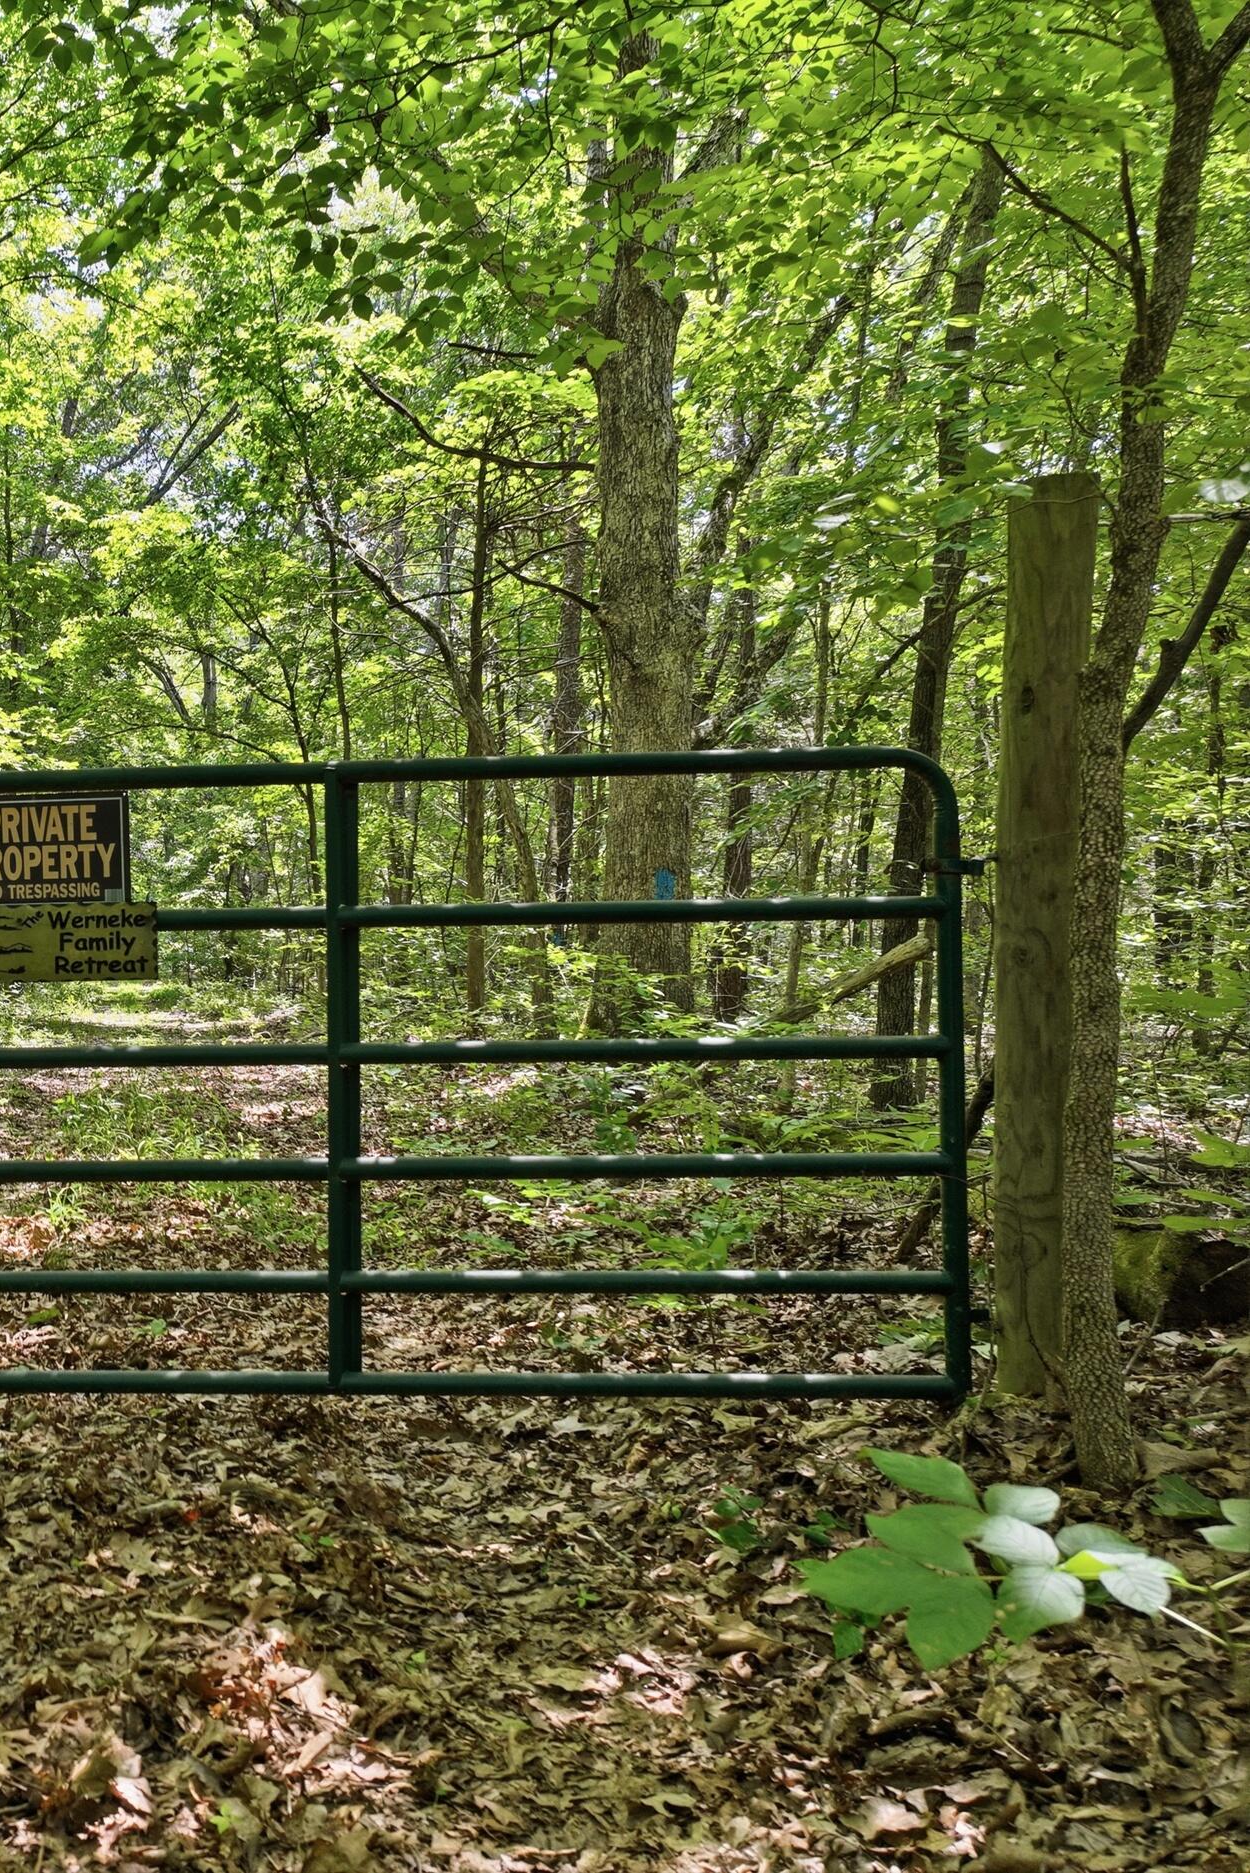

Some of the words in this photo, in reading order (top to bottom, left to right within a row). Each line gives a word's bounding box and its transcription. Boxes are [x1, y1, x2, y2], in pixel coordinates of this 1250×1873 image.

[8, 882, 100, 899] TRESPASSING
[22, 910, 45, 929] The
[48, 908, 147, 930] Werneke
[59, 931, 136, 956] Family
[54, 956, 149, 975] Retreat
